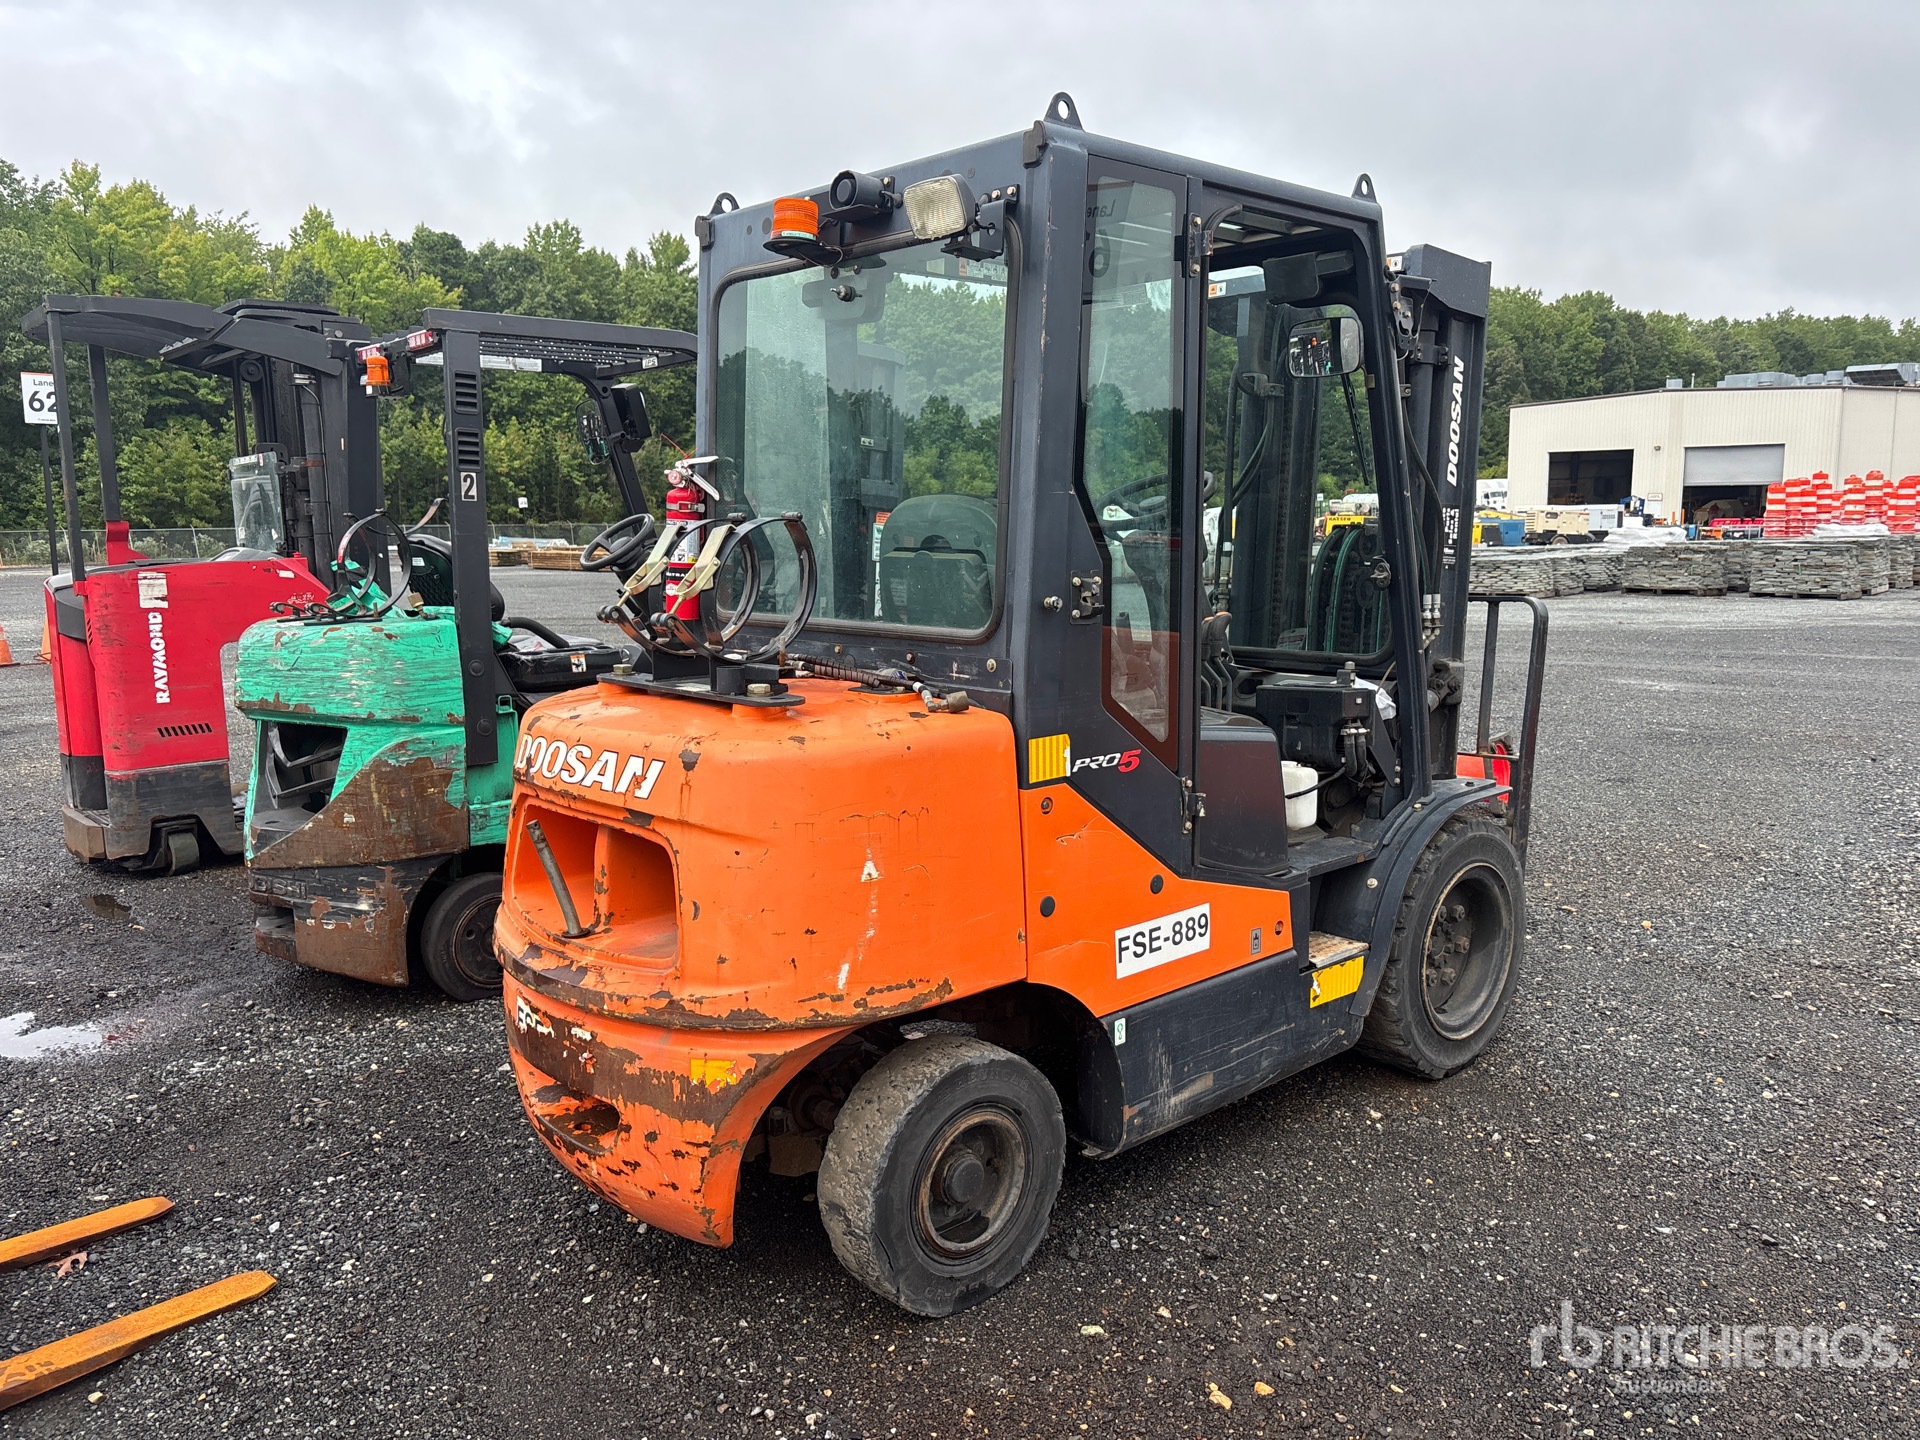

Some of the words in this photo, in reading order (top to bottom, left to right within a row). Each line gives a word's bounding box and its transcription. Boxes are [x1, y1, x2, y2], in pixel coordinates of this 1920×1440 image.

[33, 378, 54, 387] Lane
[1447, 355, 1465, 487] DOOSAN
[462, 473, 476, 500] 2
[147, 611, 171, 704] RAYMOND
[516, 732, 666, 800] DOOSAN
[1072, 748, 1142, 773] PRO5
[1117, 912, 1209, 964] FSE-889
